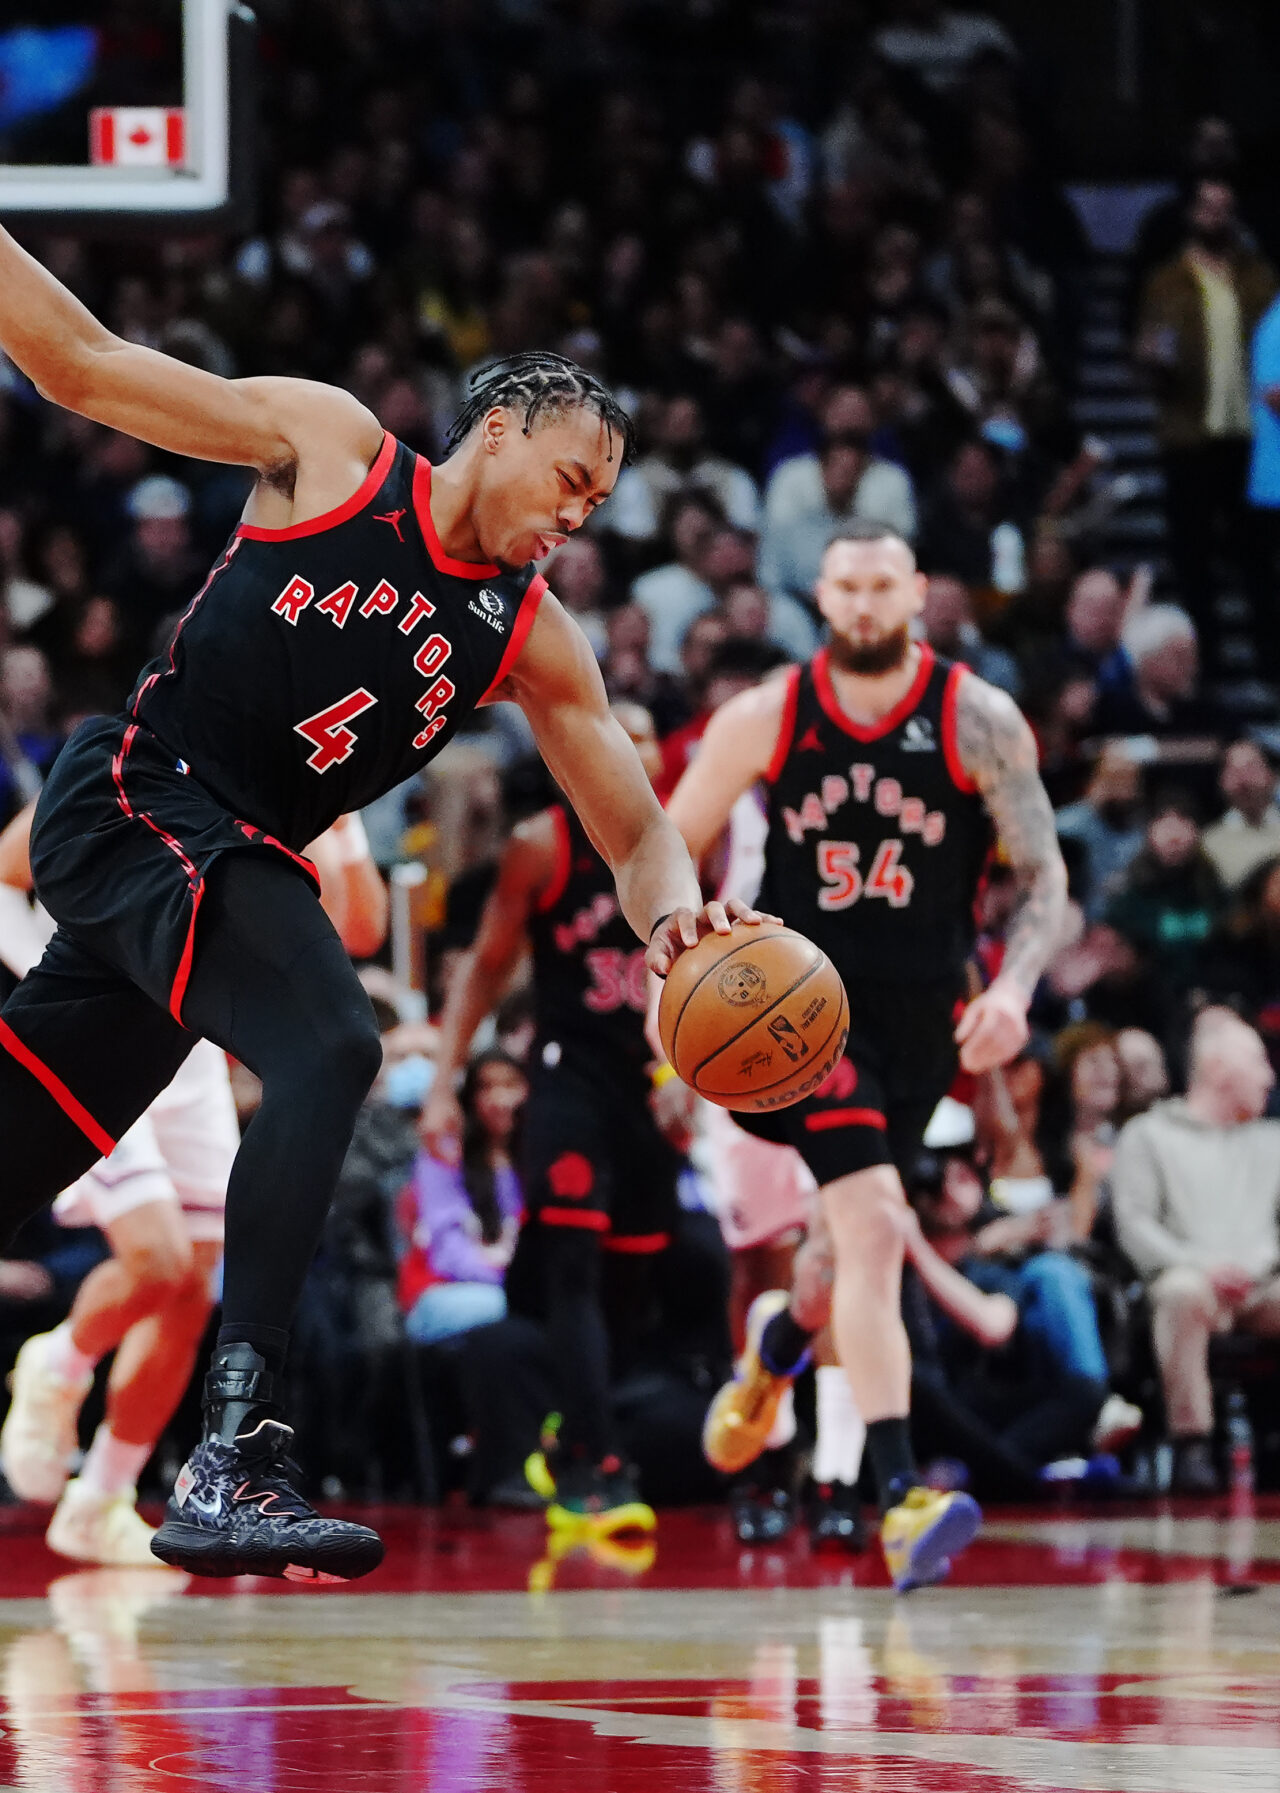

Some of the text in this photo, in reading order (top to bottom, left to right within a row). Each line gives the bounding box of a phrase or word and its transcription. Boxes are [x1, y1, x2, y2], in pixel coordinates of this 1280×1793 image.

[467, 600, 505, 634] Sun Life
[270, 573, 456, 750] RAPTORS
[292, 686, 379, 775] 4
[816, 838, 915, 912] 54
